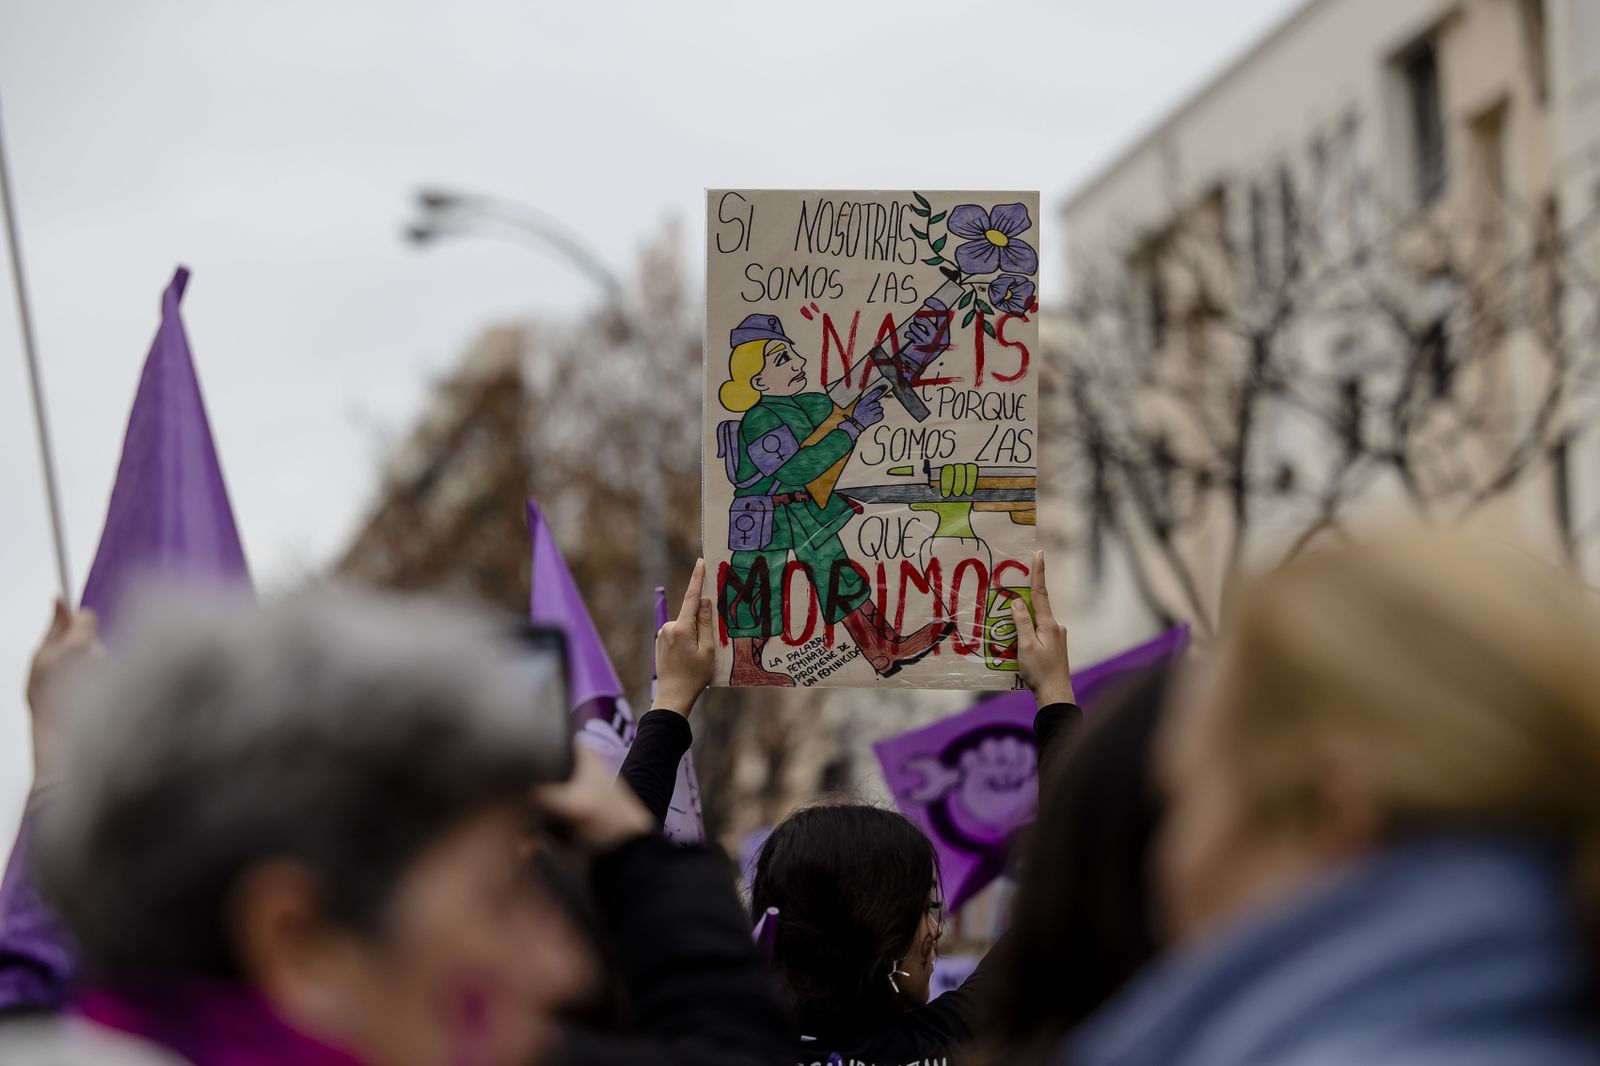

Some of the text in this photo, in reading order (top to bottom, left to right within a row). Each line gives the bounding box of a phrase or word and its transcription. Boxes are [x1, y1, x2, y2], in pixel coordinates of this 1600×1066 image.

[717, 191, 916, 265] SI NOSOTRAS
[741, 263, 919, 304] SOMOS LAS
[860, 425, 1033, 465] SOMOS LAS
[858, 516, 920, 560] QUE
[717, 555, 1029, 657] MORIMOS
[769, 633, 830, 668] LA PALABRA
[786, 647, 828, 674] FEMINAZI
[794, 642, 850, 684] PROVIENE DE
[802, 676, 818, 687] UN
